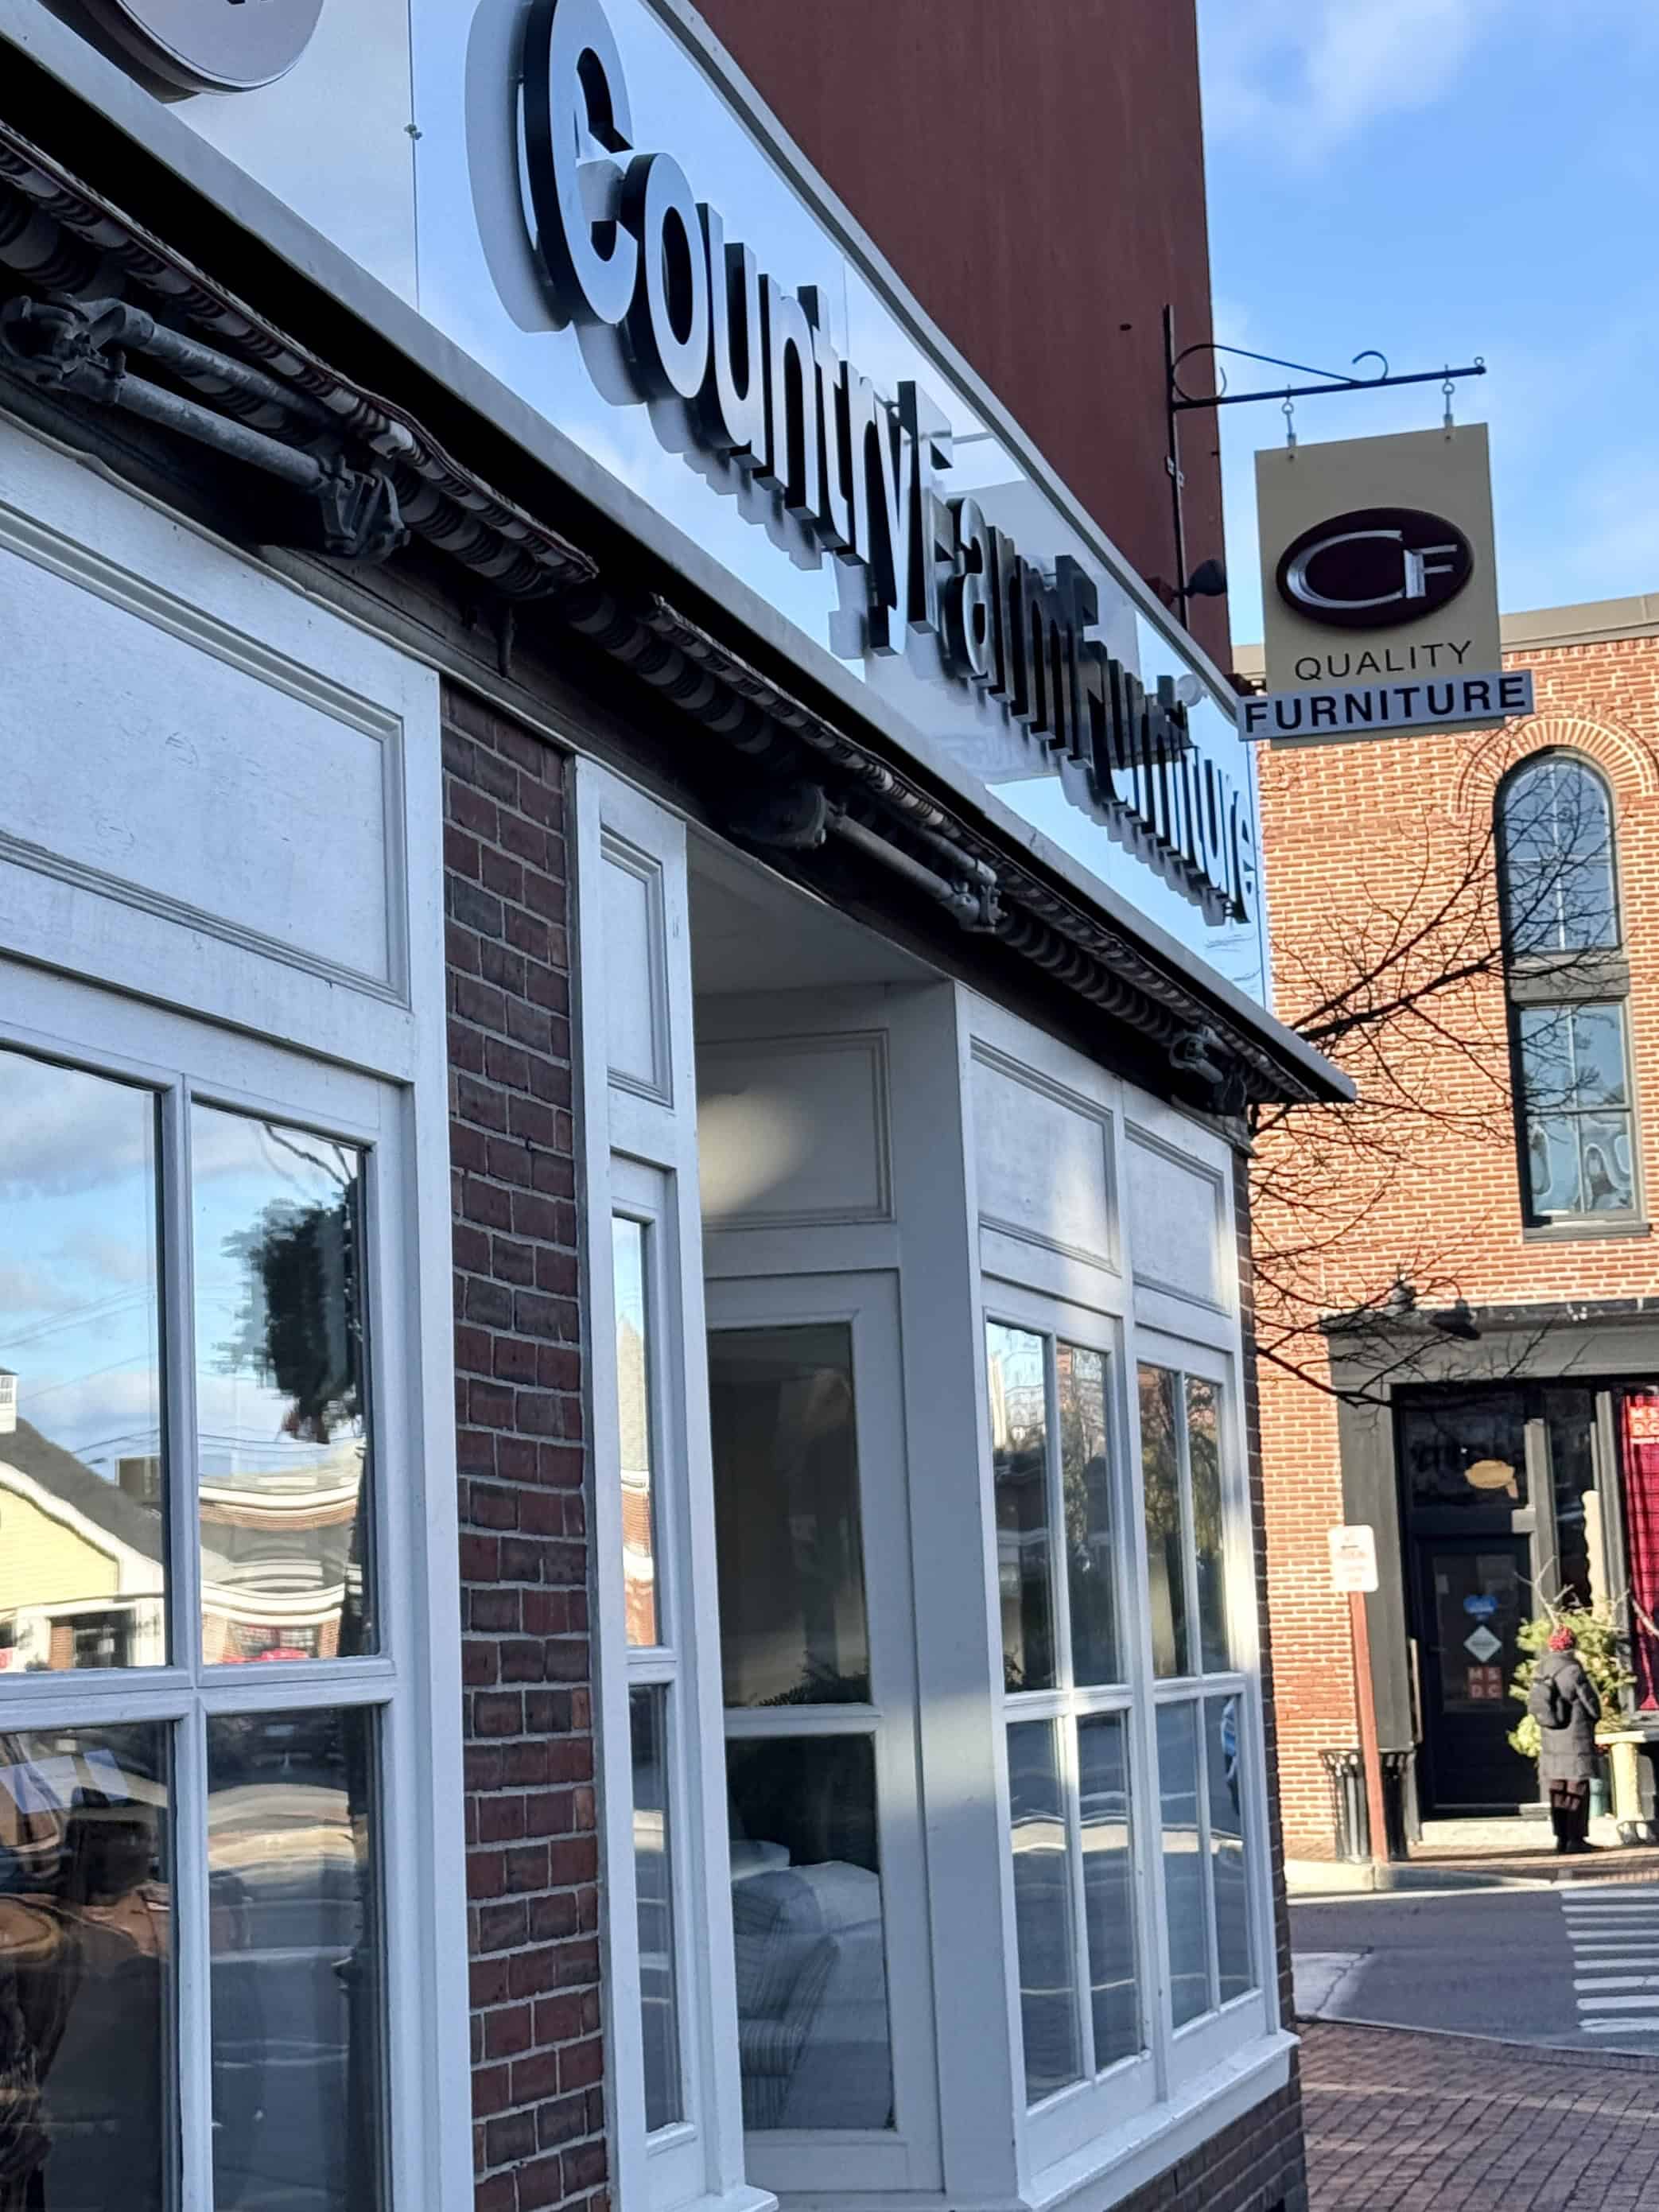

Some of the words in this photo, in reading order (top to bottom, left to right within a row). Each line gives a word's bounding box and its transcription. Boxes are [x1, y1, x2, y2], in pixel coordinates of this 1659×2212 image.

[517, 0, 915, 655] Country
[1055, 554, 1257, 924] Furniture
[1286, 530, 1459, 609] CF
[1295, 640, 1471, 682] QUALITY
[1245, 676, 1525, 733] FURNITURE
